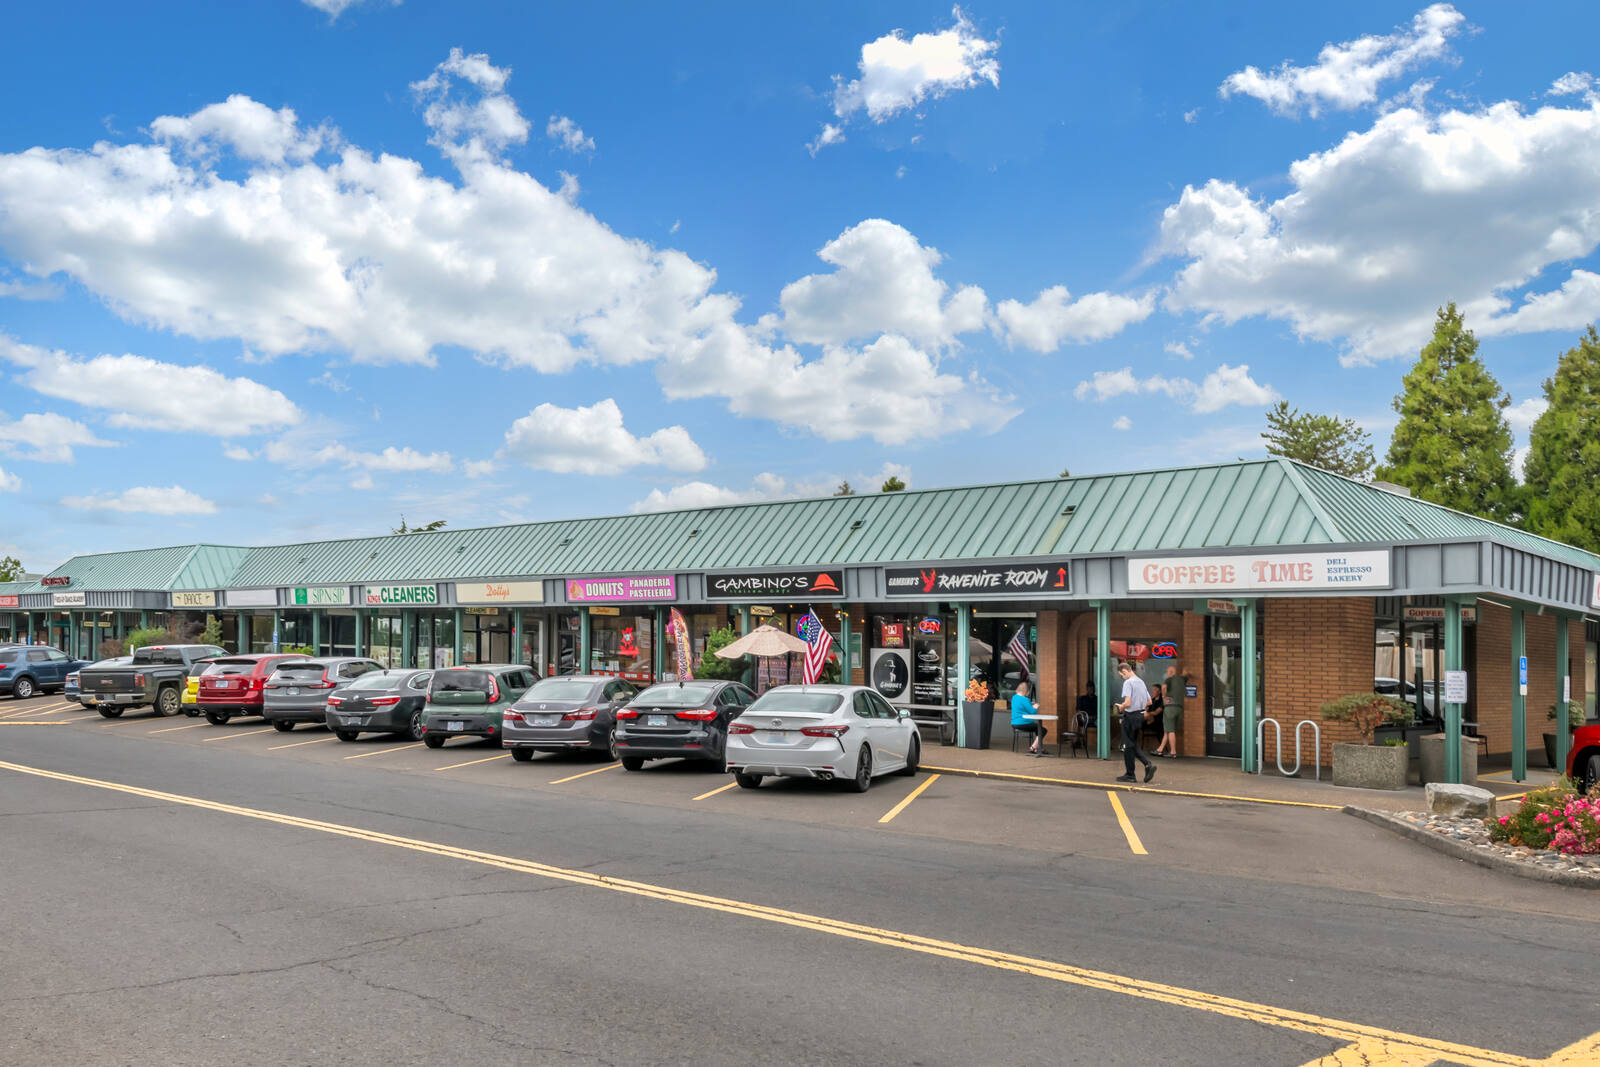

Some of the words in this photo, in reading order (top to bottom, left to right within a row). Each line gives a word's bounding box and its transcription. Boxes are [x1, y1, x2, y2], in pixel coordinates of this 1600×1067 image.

[1326, 558, 1347, 566] DELI
[1142, 563, 1236, 584] COFFEE
[1252, 560, 1314, 583] TIME
[1327, 566, 1373, 575] ESPRESSO
[630, 578, 671, 588] PANADERIA
[715, 576, 809, 592] GAMBINO'S
[938, 569, 1002, 588] RAVENITE
[1004, 568, 1049, 588] ROOM
[1327, 574, 1364, 583] BAKERY
[381, 587, 436, 603] CLEANERS
[586, 582, 625, 597] DONUTS
[629, 588, 673, 598] PASTELERIA
[184, 593, 203, 605] DANCE
[919, 621, 941, 633] OPEN
